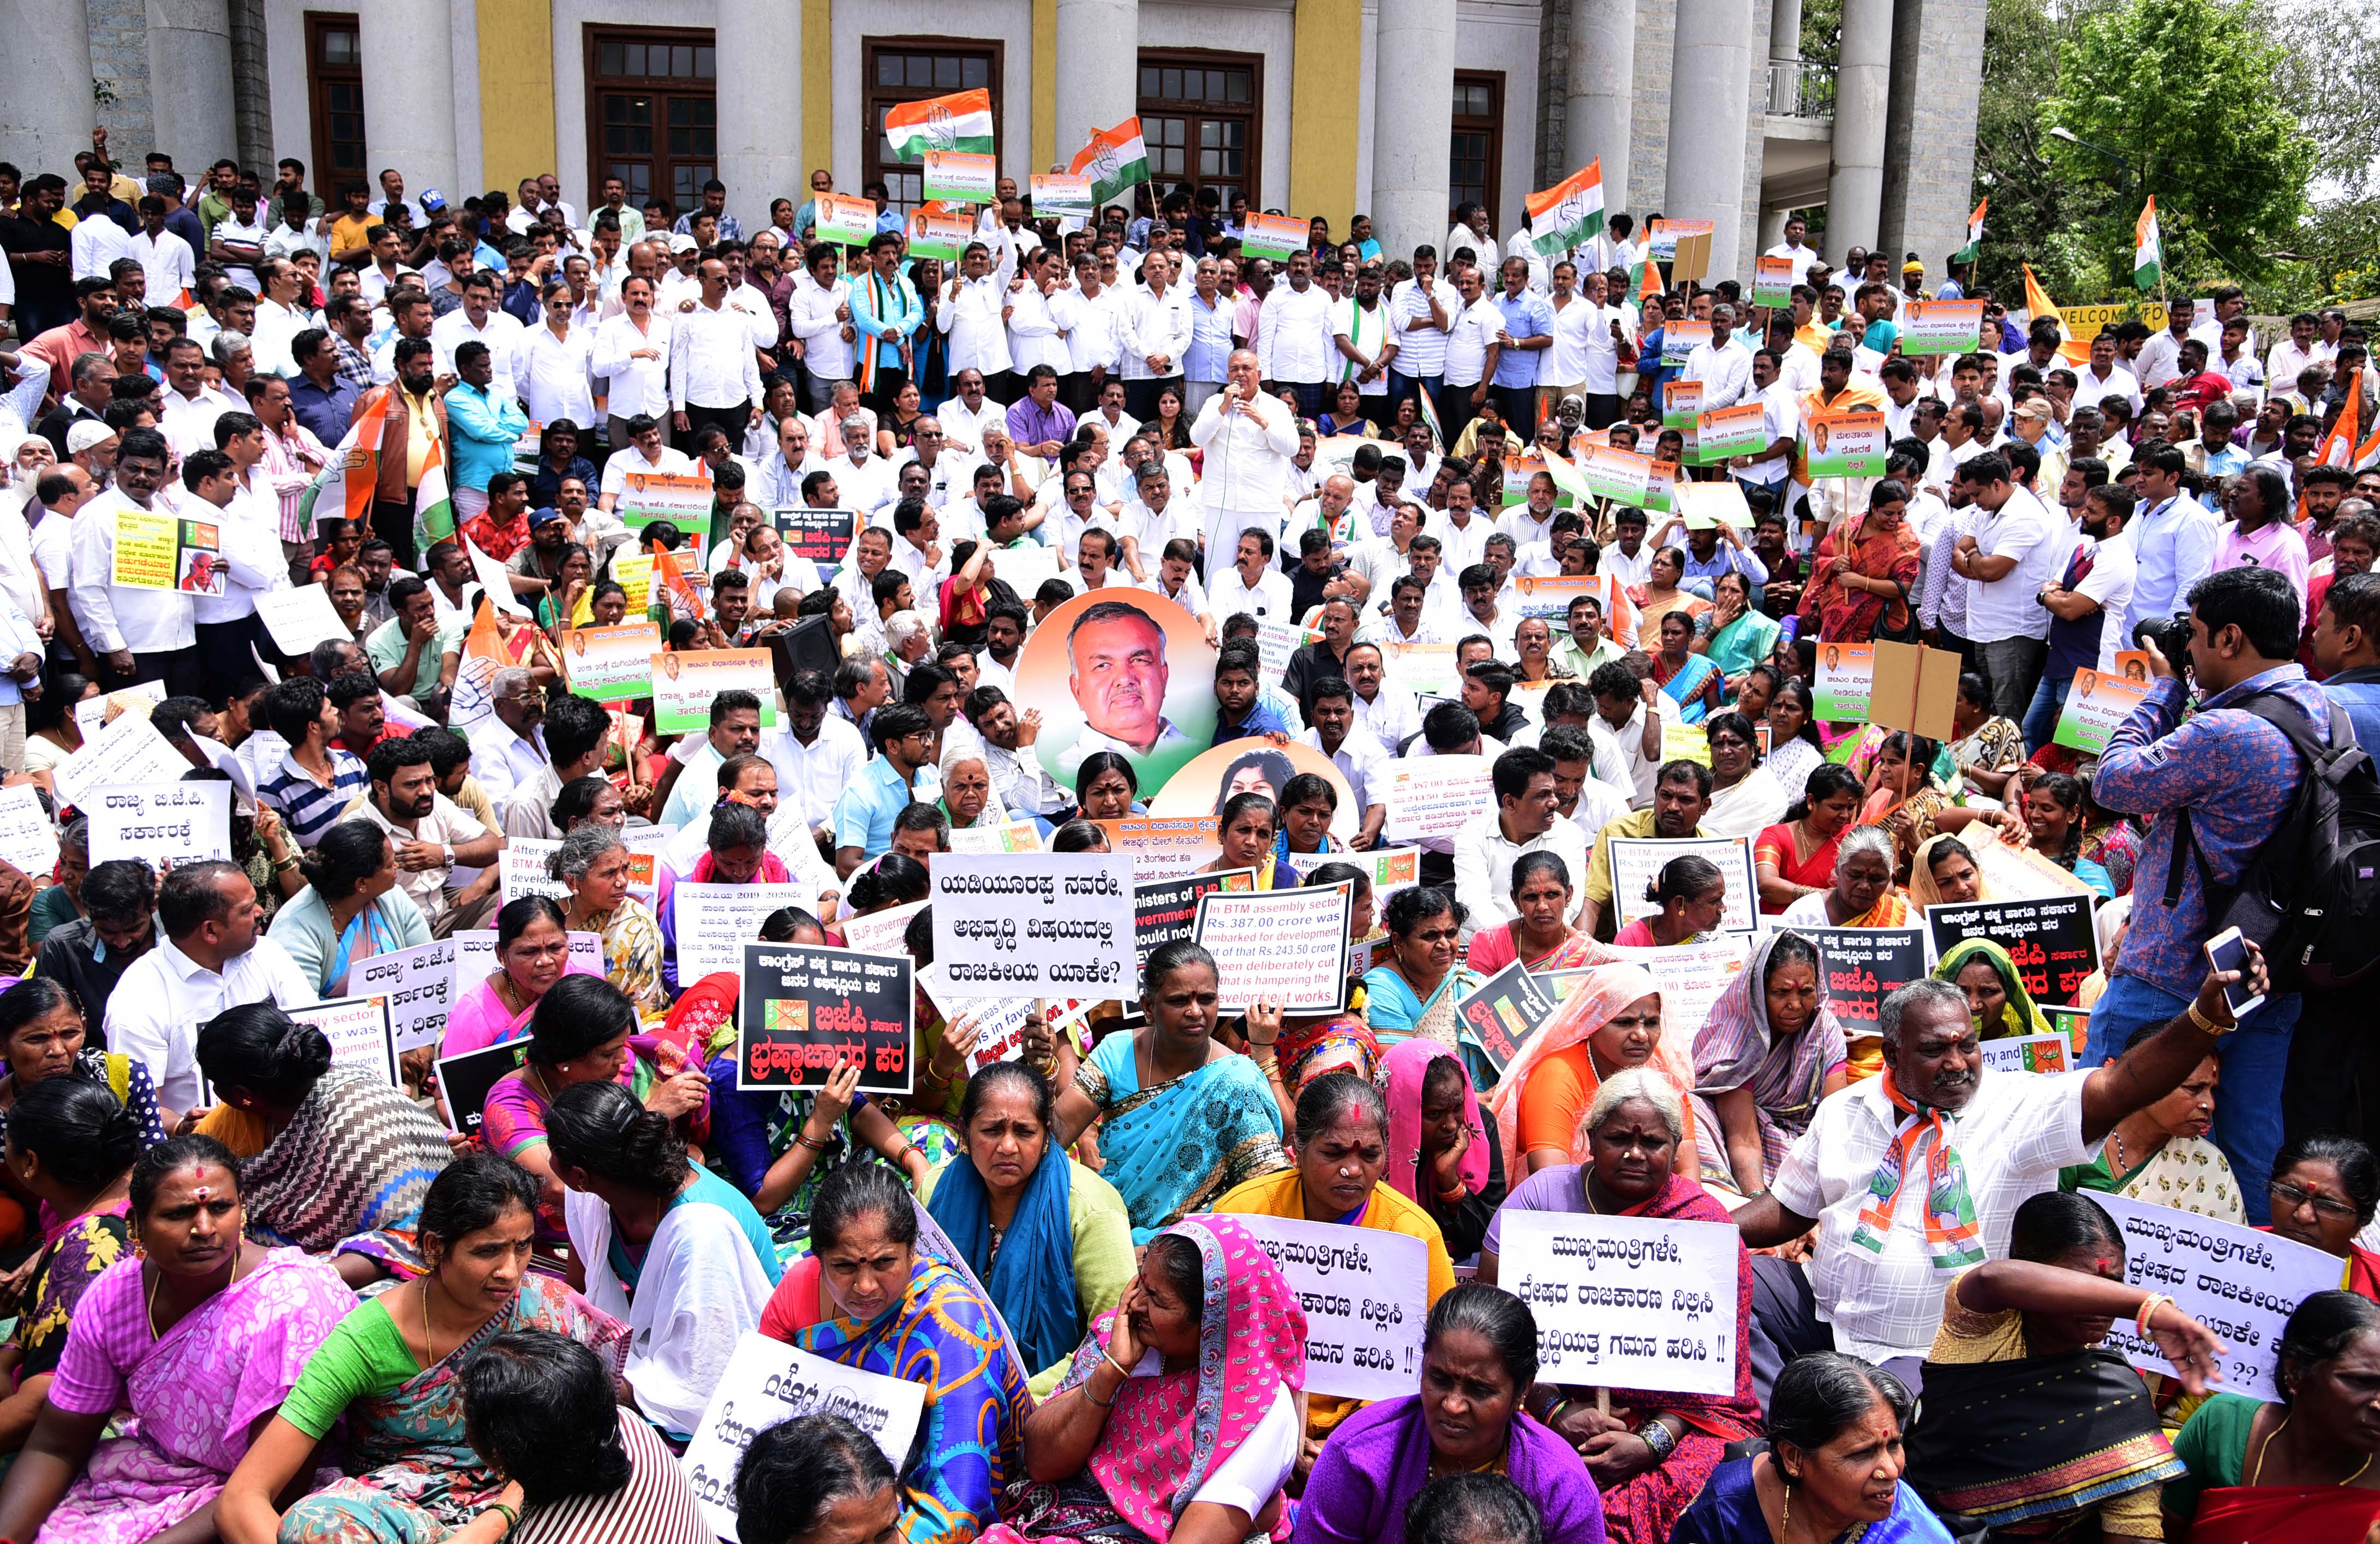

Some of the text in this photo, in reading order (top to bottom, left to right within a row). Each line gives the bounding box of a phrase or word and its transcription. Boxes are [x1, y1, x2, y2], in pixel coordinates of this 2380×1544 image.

[106, 794, 145, 816] ರಾಜ್ಯ
[120, 819, 191, 845] ಸರ್ಕಾರಕ್ಕೆ
[1151, 821, 1194, 830] ವಿಧಾನಸಭಾ
[1198, 820, 1217, 831] ಕ್ಷೇತ್ರ
[1707, 848, 1738, 856] sector
[512, 860, 533, 869] BTM
[941, 869, 1122, 904] ಯಡಿಯೂರಪ್ಪ ನವರೇ,
[1181, 889, 1193, 901] of
[1210, 897, 1341, 914] In BTM assembly sector
[1941, 902, 2077, 926] ಕಾಂಗ್ರೆಸ್ ಪಕ್ಷ ಹಾಗೂ ಸರ್ಕಾರ
[1207, 913, 1340, 928] Rs.387.00 crore was
[1962, 919, 2059, 938] ಜನರ ಅಭಿವೃದ್ಧಿಯ ಪರ
[853, 925, 870, 940] BJP
[954, 917, 1113, 952] ಅಭಿವೃದ್ಧಿ ವಿಷಯದಲ್ಲಿ
[1172, 925, 1193, 940] not
[1204, 927, 1341, 943] embarked for development,
[1823, 934, 1911, 949] ಪಕ್ಷ ಹಾಗೂ ಸರ್ಕಾರ
[1222, 944, 1336, 957] of that Rs.243.50 crore
[1827, 949, 1893, 965] ಅಭಿವೃದ್ಧಿಯ ಪರ
[2051, 949, 2087, 961] ಸರ್ಕಾರ
[366, 962, 404, 983] ರಾಜ್ಯ
[759, 953, 898, 977] ಕಾಂಗ್ರೆಸ್ ಪಕ್ಷ ಹಾಗೂ ಸರ್ಕಾರ
[949, 957, 1121, 983] ರಾಜಕೀಯ ಯಾಕೇ?
[1246, 958, 1315, 971] deliberately
[1318, 957, 1335, 968] cut
[781, 973, 880, 997] ಜನರ ಅಭಿವೃದ್ಧಿಯ ಪರ
[1243, 976, 1252, 985] is
[1254, 974, 1311, 988] hampering
[1314, 973, 1330, 983] the
[1829, 967, 1878, 993] ಬಿಜೆಪಿ
[1295, 989, 1333, 1003] works.
[333, 1010, 375, 1024] sector
[815, 997, 902, 1034] ಬಿಜೆಪಿ ಸರ್ಕಾರ
[346, 1025, 378, 1038] was
[991, 1023, 1003, 1035] in
[750, 1035, 904, 1085] ಭ್ರಷ್ಟಾಚಾರದ ಪರ
[2000, 1047, 2020, 1060] and
[1552, 1234, 1682, 1271] ಮುಖ್ಯಮಂತ್ರಿಗಳೇ,
[2125, 1216, 2275, 1273] ಮುಖ್ಯಮಂತ್ರಿಗಳೇ,
[2128, 1253, 2188, 1285] ದ್ವೇಷದ
[1578, 1284, 1663, 1310] ರಾಜಕಾರಣ
[1672, 1289, 1713, 1322] ನಿಲ್ಲಿಸಿ
[1361, 1298, 1403, 1333] ನಿಲ್ಲಿಸಿ
[1610, 1335, 1657, 1358] ಗಮನ
[1666, 1337, 1707, 1361] ಹರಿಸಿ
[1354, 1345, 1395, 1371] ಹರಿಸಿ
